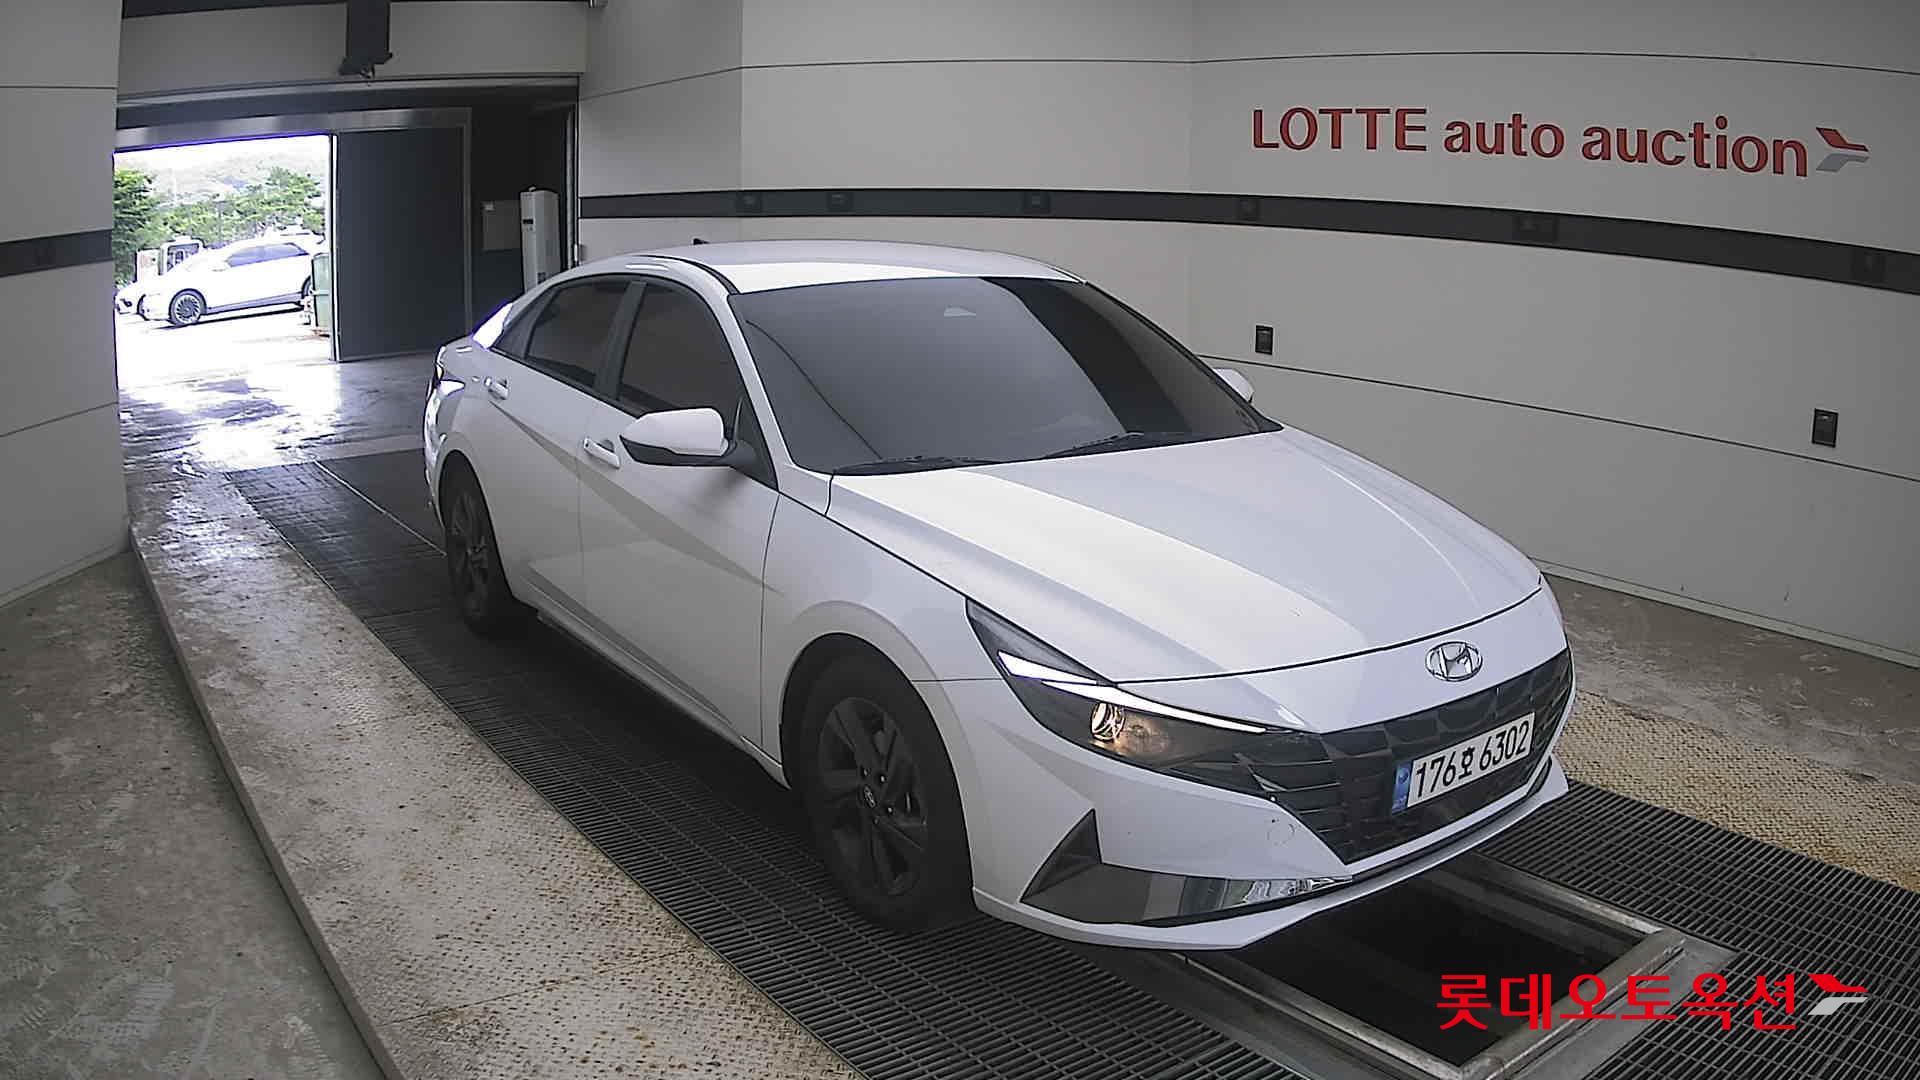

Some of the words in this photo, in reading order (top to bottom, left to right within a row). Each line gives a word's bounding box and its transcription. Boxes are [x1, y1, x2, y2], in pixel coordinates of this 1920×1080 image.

[1252, 107, 1428, 152] LOTTE
[1443, 113, 1566, 157] auto
[1581, 115, 1808, 177] auction
[1415, 746, 1476, 798] 176호
[1479, 719, 1530, 771] 6302
